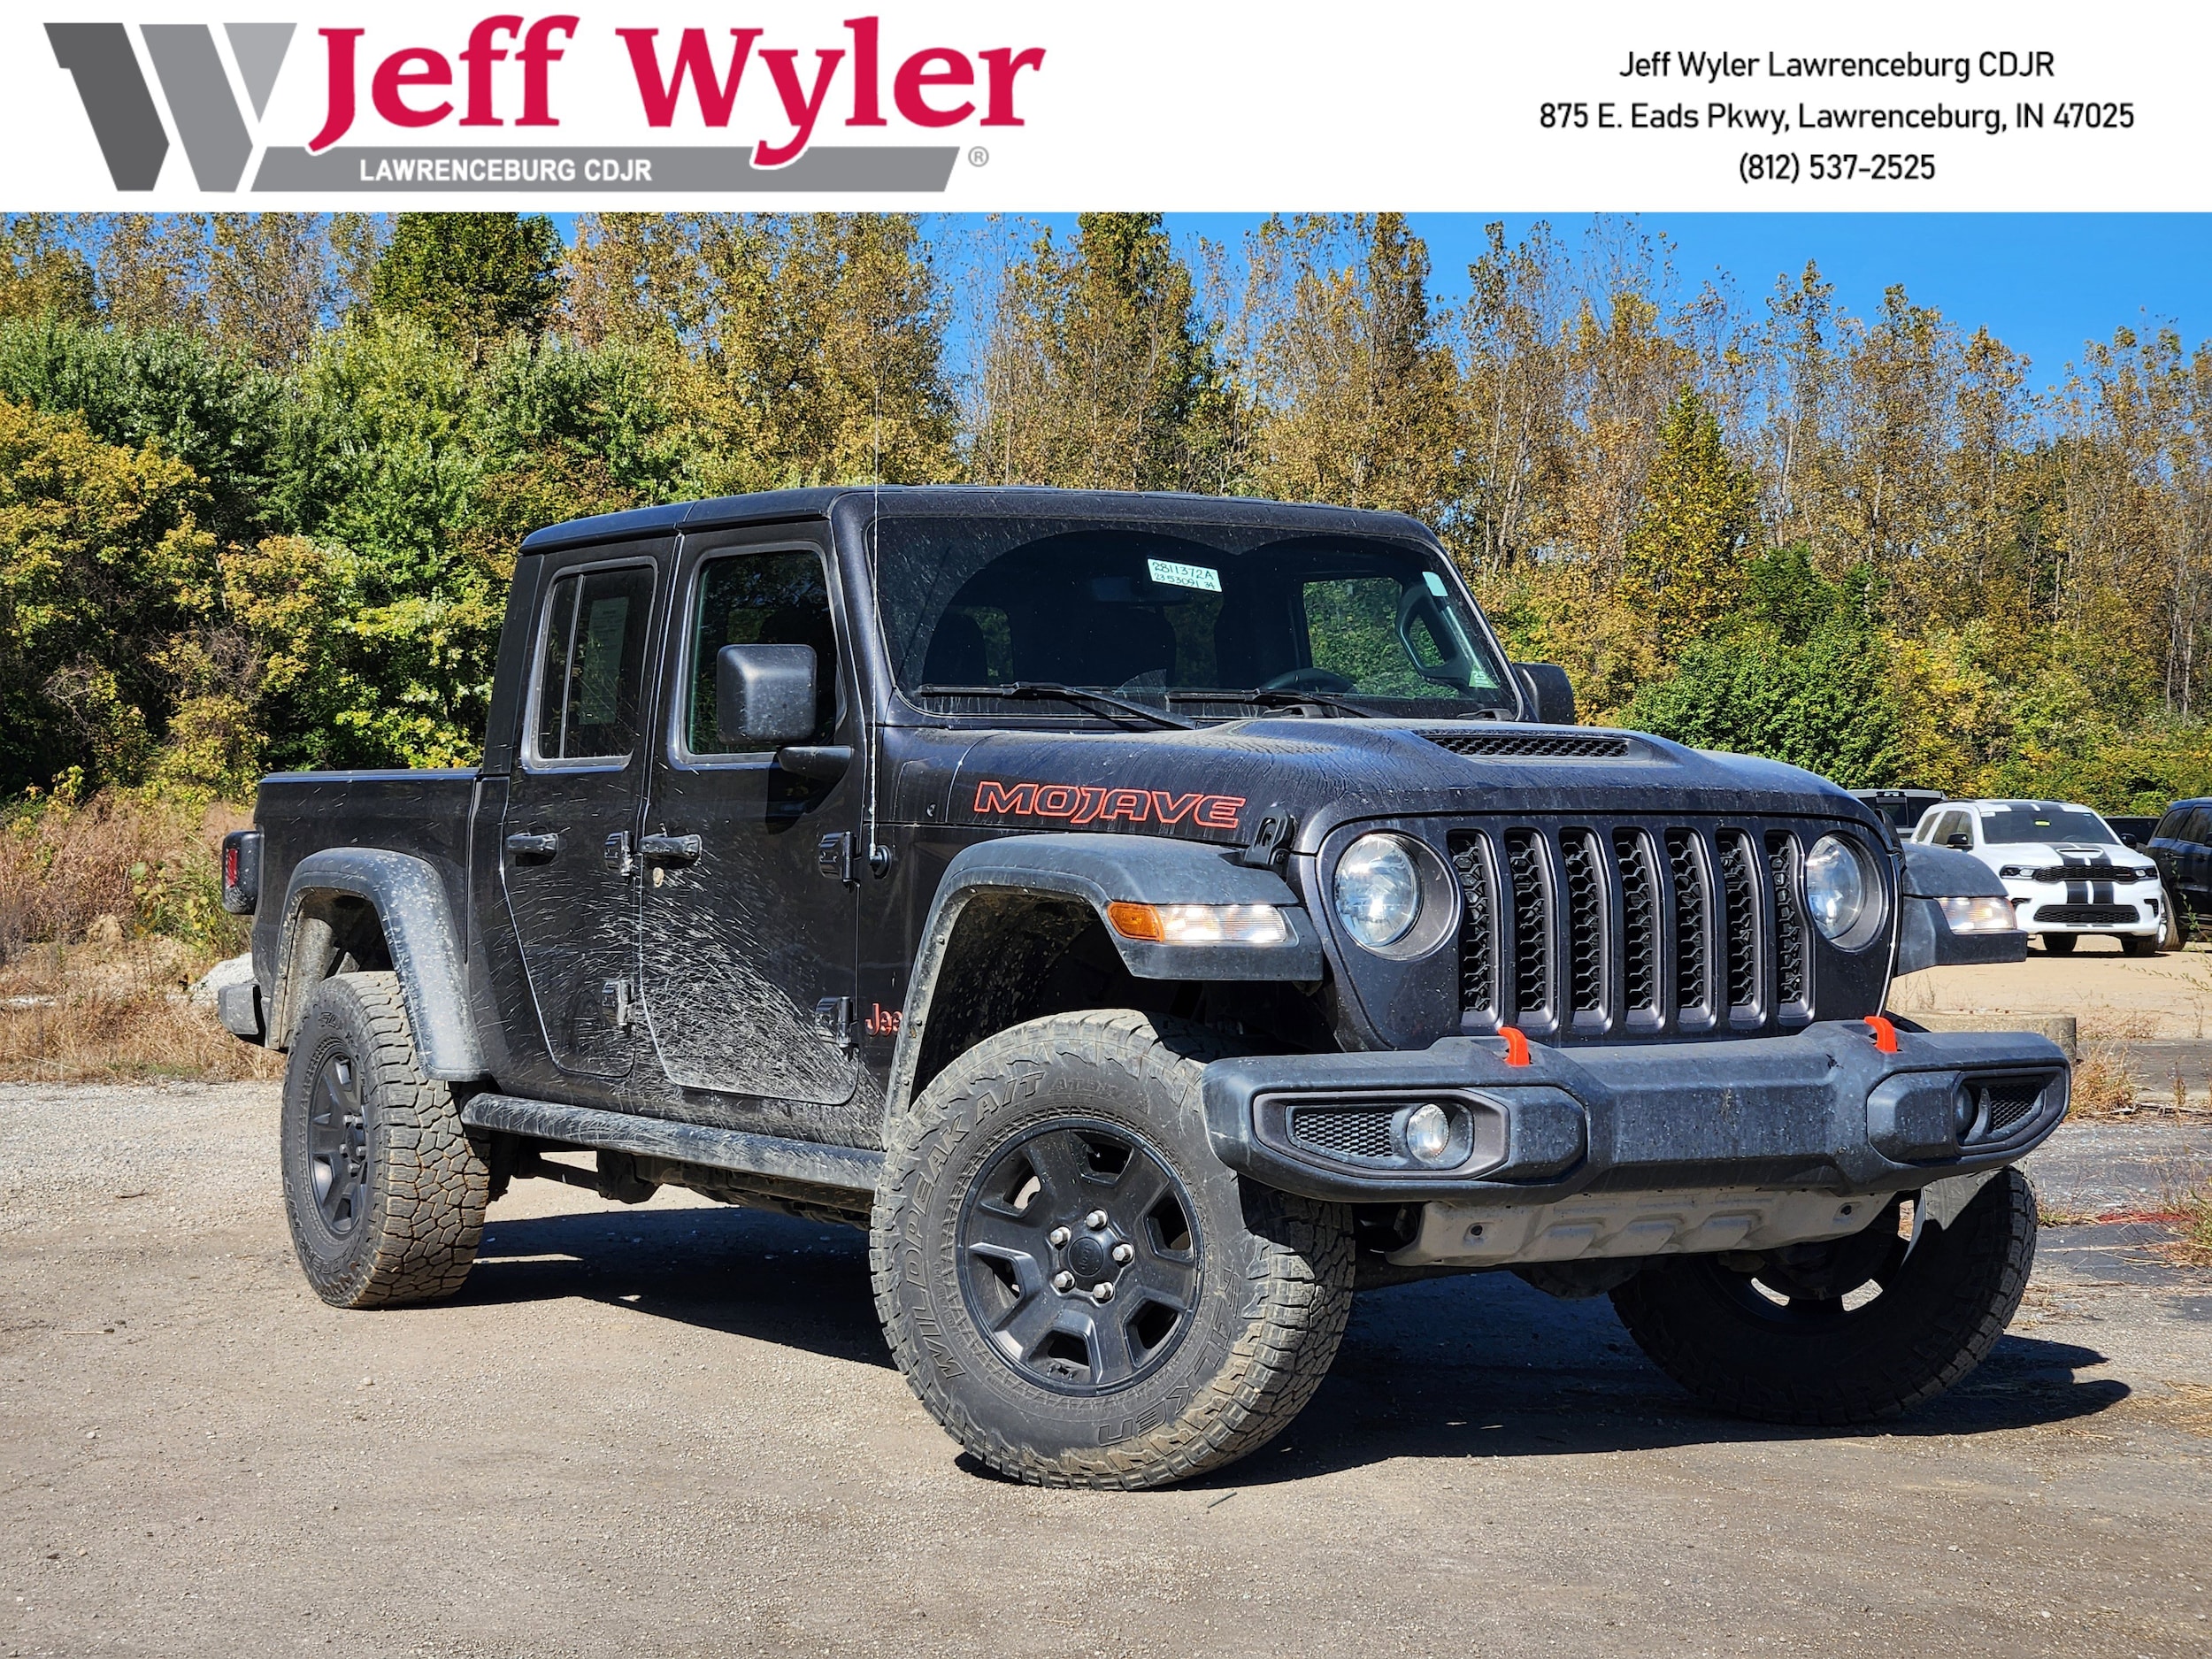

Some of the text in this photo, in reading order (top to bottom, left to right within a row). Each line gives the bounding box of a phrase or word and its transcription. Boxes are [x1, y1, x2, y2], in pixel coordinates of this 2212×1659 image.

[974, 780, 1247, 829] MOJAVE
[864, 1002, 903, 1036] Jee
[905, 1112, 970, 1379] WILDPEAK
